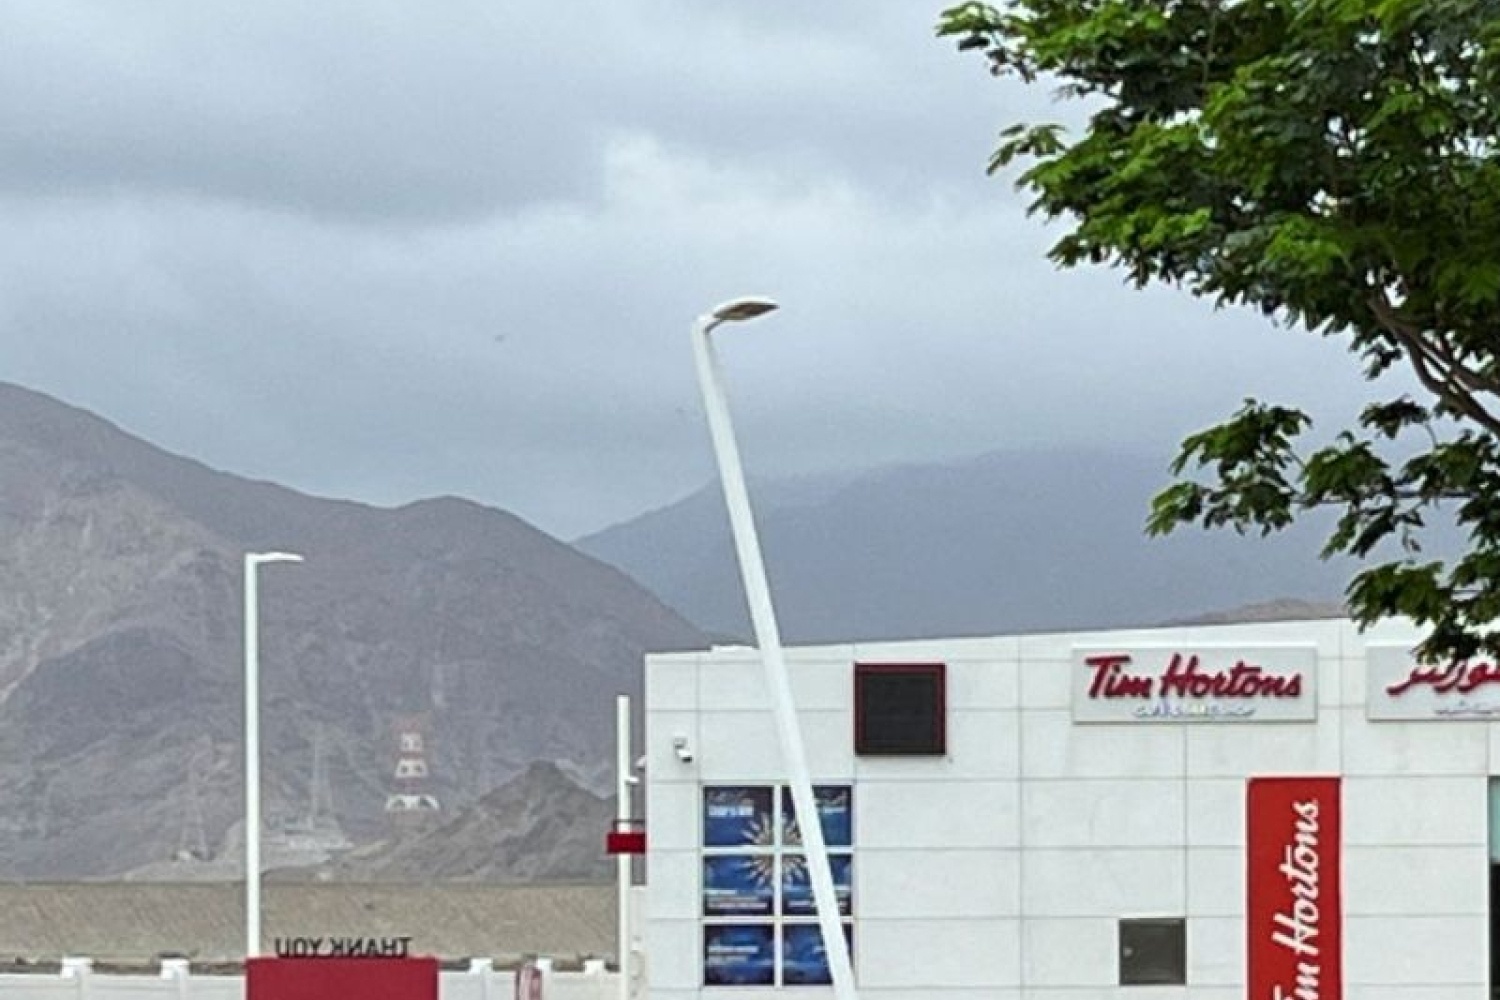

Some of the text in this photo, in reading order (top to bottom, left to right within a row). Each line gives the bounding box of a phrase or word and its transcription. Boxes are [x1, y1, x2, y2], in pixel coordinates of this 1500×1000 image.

[1084, 652, 1303, 699] Tim Hortons
[1271, 799, 1321, 955] Hortons
